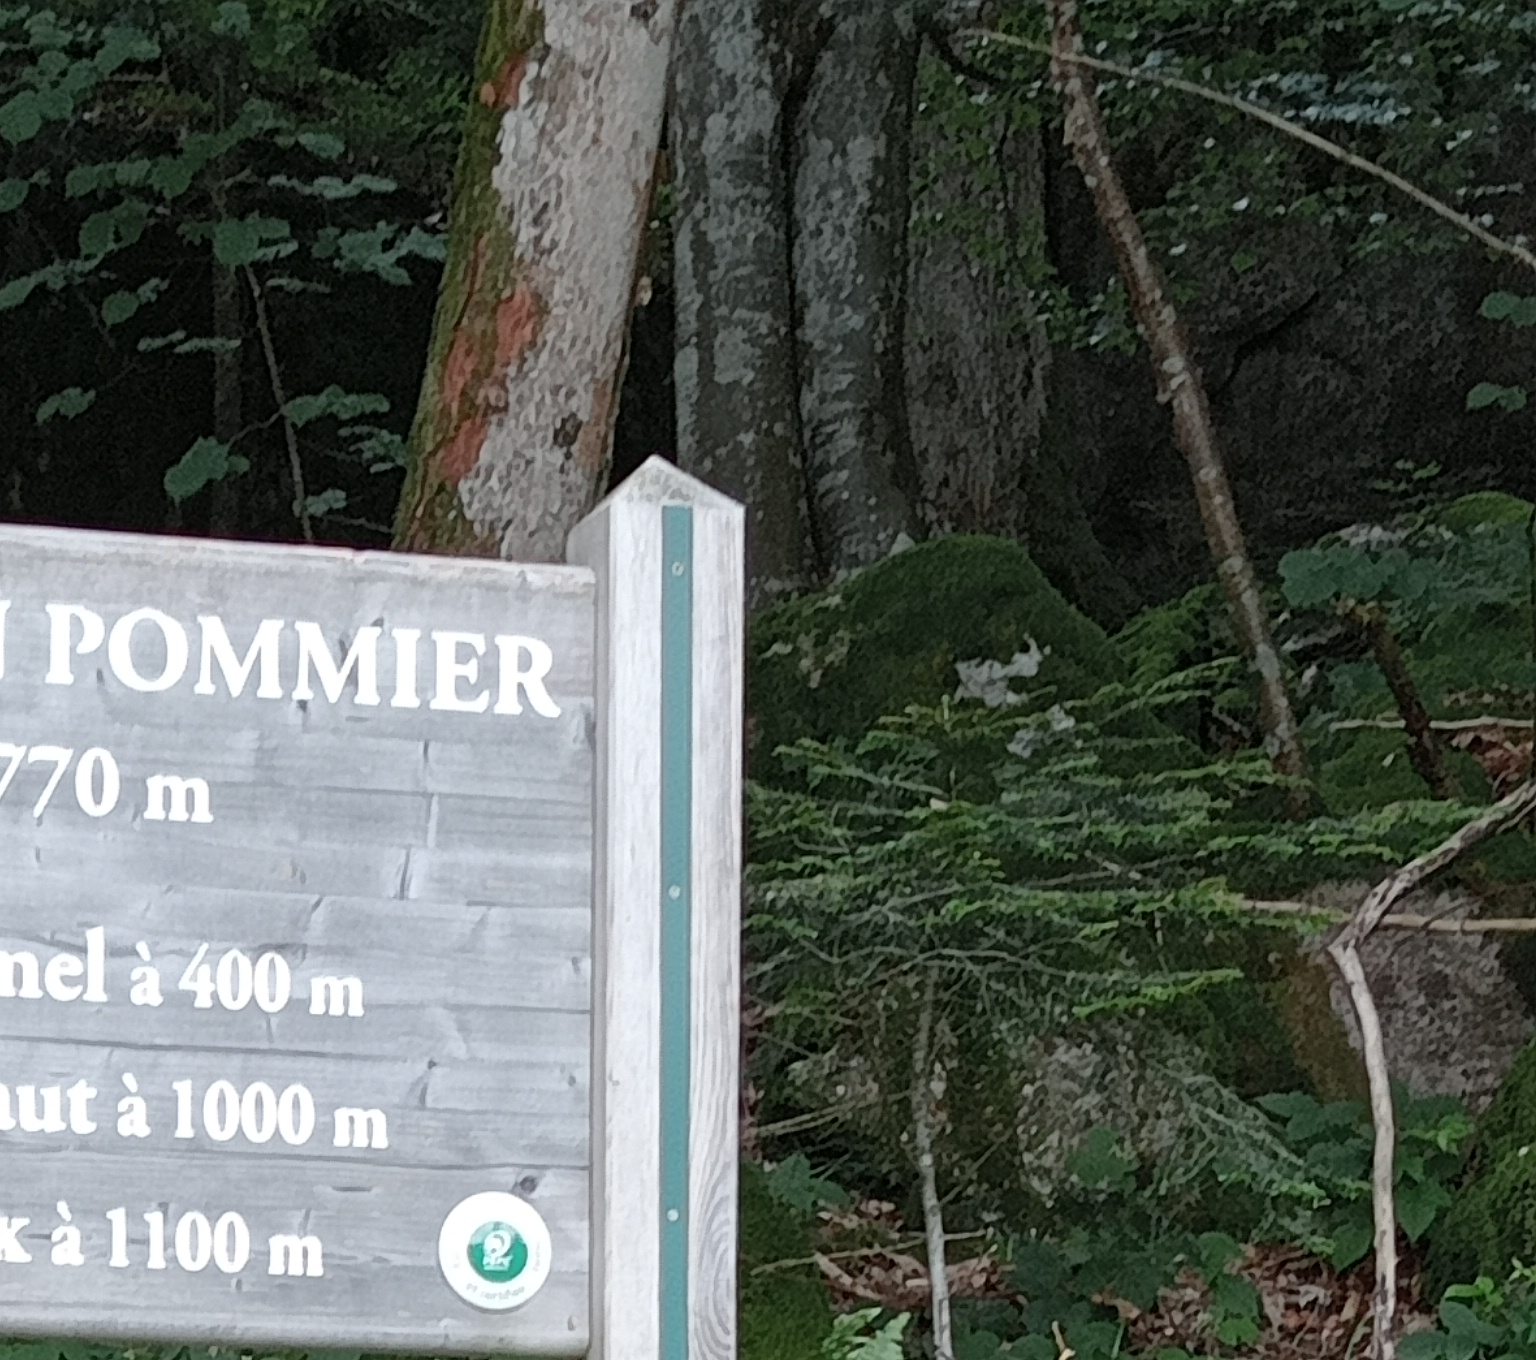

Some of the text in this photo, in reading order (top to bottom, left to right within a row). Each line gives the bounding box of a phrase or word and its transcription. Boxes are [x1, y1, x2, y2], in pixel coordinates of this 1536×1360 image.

[45, 603, 562, 718] POMMIER
[143, 774, 214, 823] m
[130, 940, 164, 1007] à
[178, 942, 292, 1013] 400
[309, 975, 364, 1017] m
[117, 1072, 151, 1138] à
[172, 1079, 315, 1145] 1000
[333, 1107, 389, 1149] m
[51, 1201, 85, 1266] à
[106, 1207, 250, 1273] 1100
[268, 1234, 324, 1277] m
